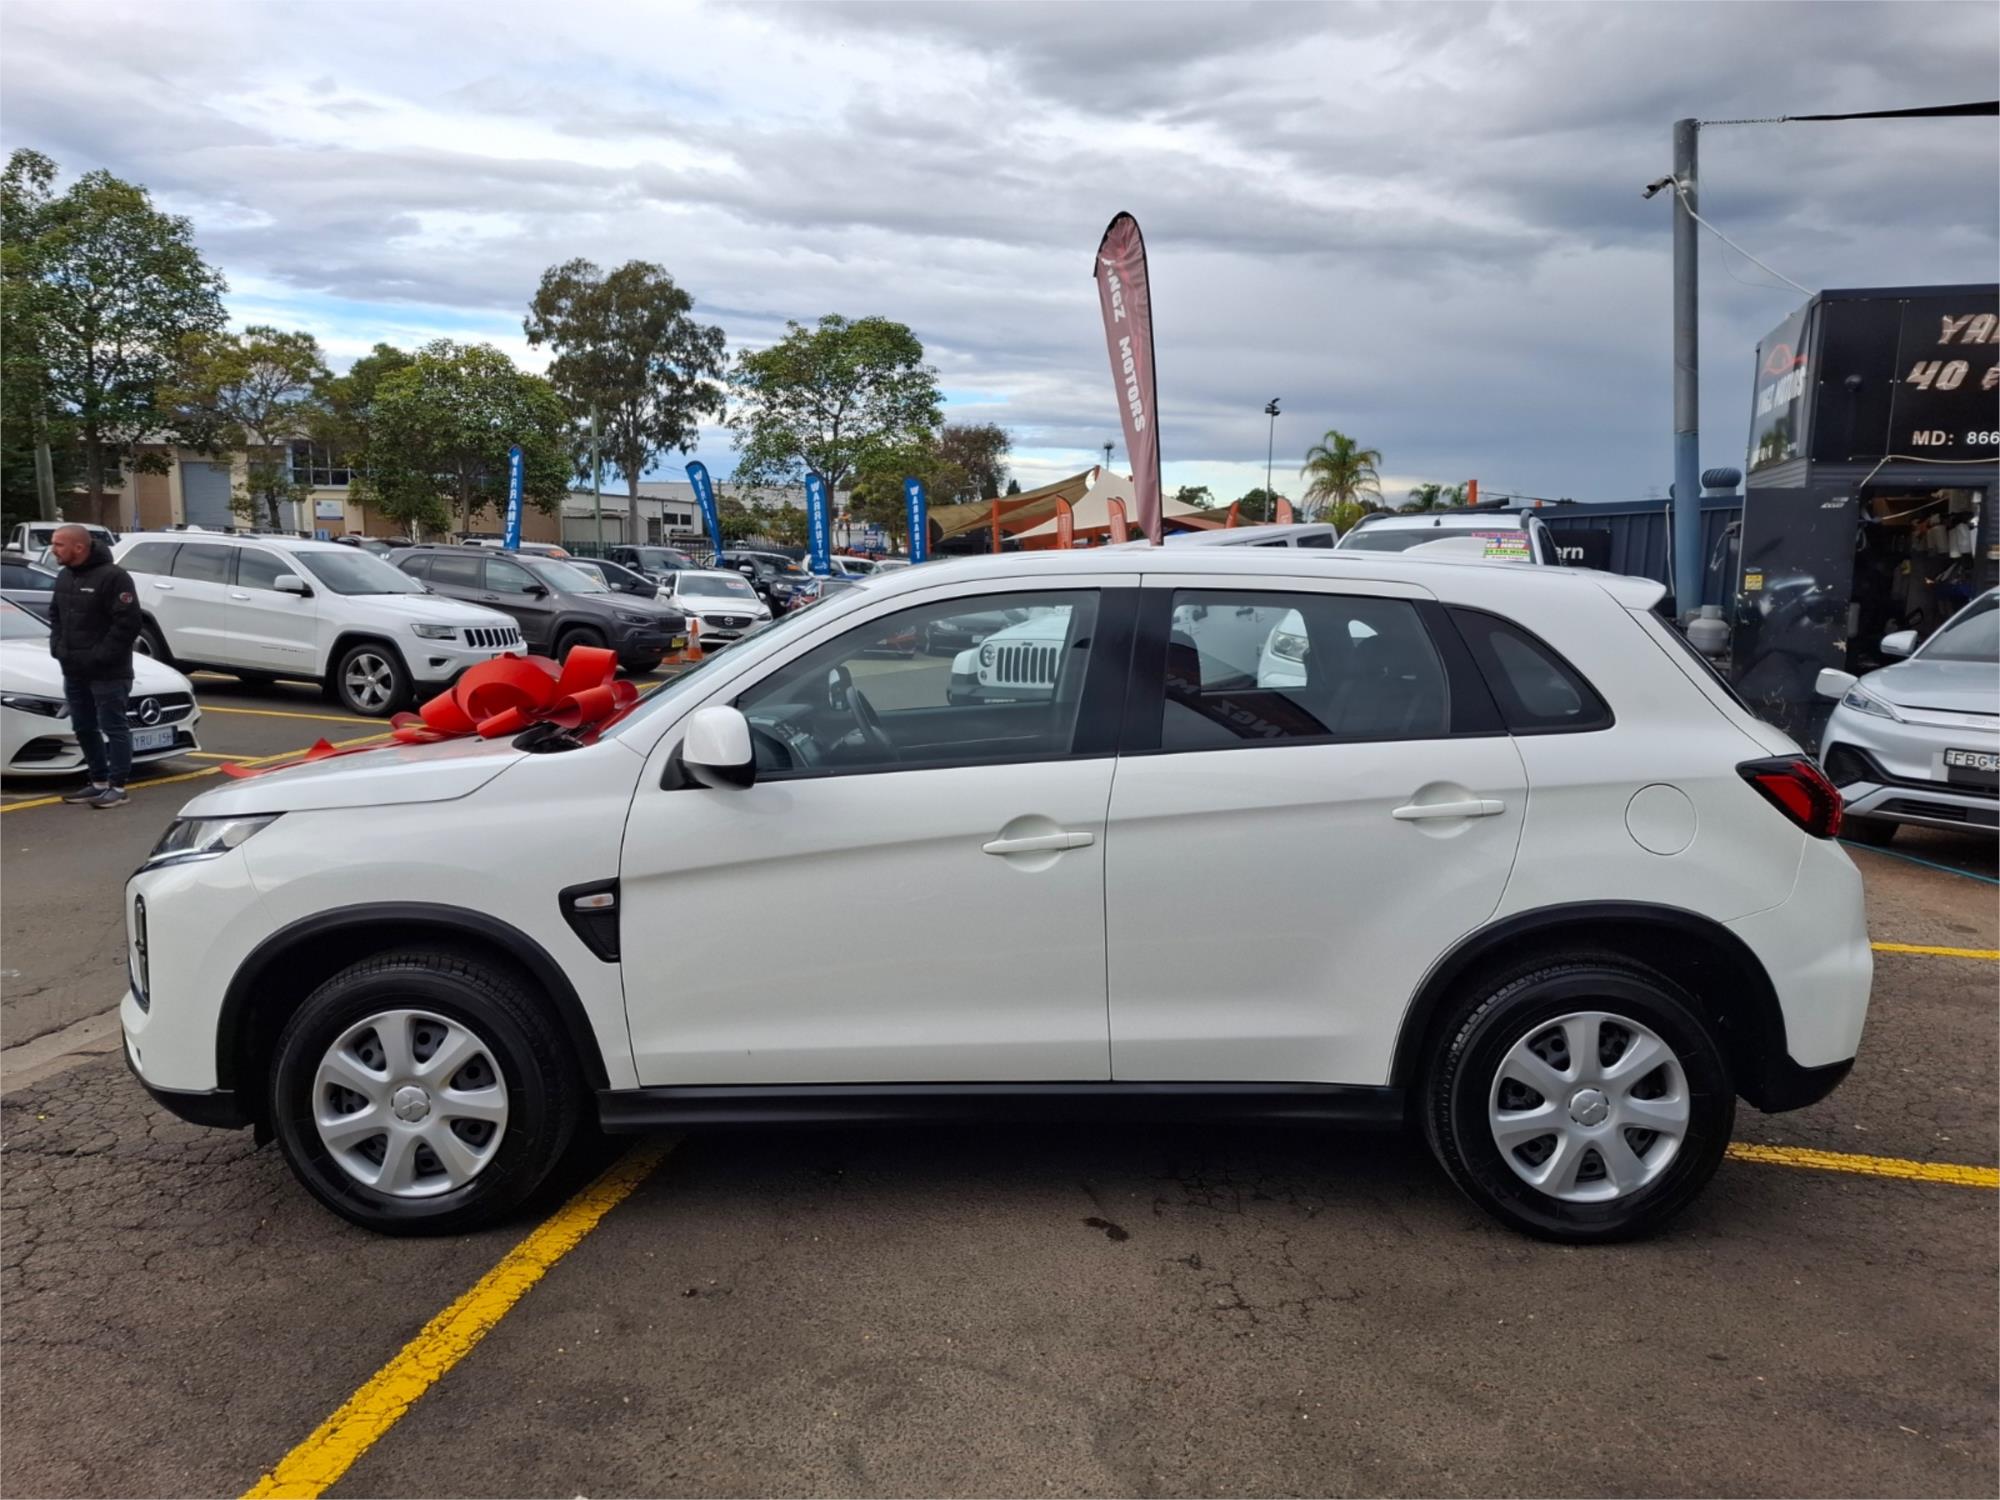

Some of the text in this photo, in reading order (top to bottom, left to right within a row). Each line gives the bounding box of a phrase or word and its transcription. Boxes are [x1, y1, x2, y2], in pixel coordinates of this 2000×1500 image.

[1101, 257, 1146, 432] YNGZ MOTORS
[1906, 360, 1970, 390] 40
[1912, 430, 1954, 446] MD:
[507, 455, 520, 544] WARRANTY
[810, 481, 824, 559] WARRANTY
[910, 485, 921, 559] WARRANTY
[1954, 753, 1988, 767] FBG
